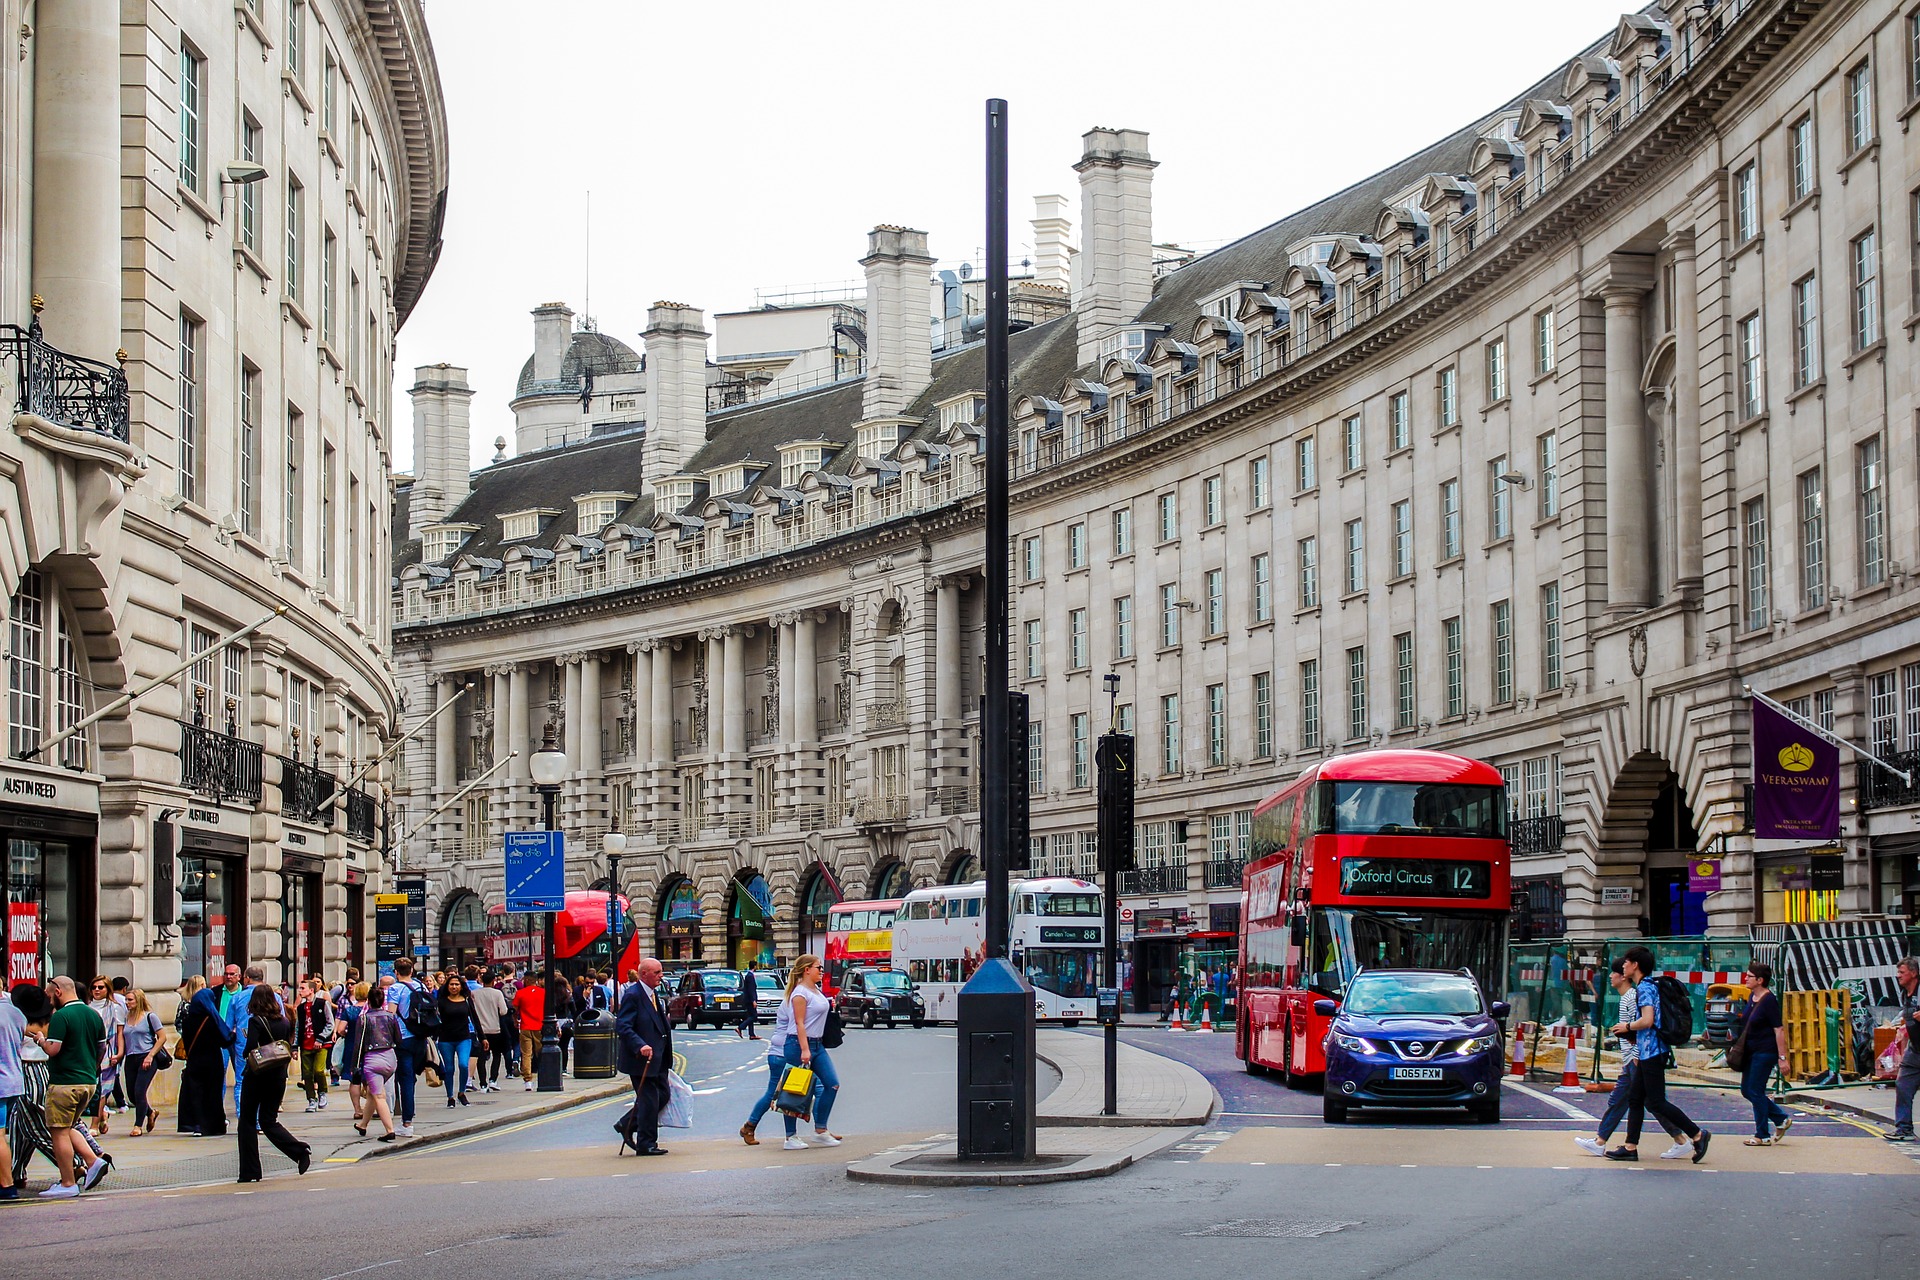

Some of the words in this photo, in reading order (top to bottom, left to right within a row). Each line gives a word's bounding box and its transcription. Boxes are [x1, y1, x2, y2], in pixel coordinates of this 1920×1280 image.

[1761, 773, 1830, 786] VEERASWAMY
[3, 777, 34, 795] AUSTIN
[34, 782, 57, 799] REED
[188, 808, 206, 822] AUSTIN
[206, 811, 220, 825] REED
[1349, 867, 1392, 882] Oxford
[1396, 869, 1433, 884] Circus
[1453, 867, 1473, 889] 12
[11, 915, 37, 942] MASSIVE
[671, 926, 689, 934] Barbour
[1083, 929, 1096, 940] 88
[598, 943, 608, 953] 12
[11, 952, 37, 980] STOCK
[1395, 1068, 1420, 1078] LO65
[1422, 1068, 1441, 1078] FXW
